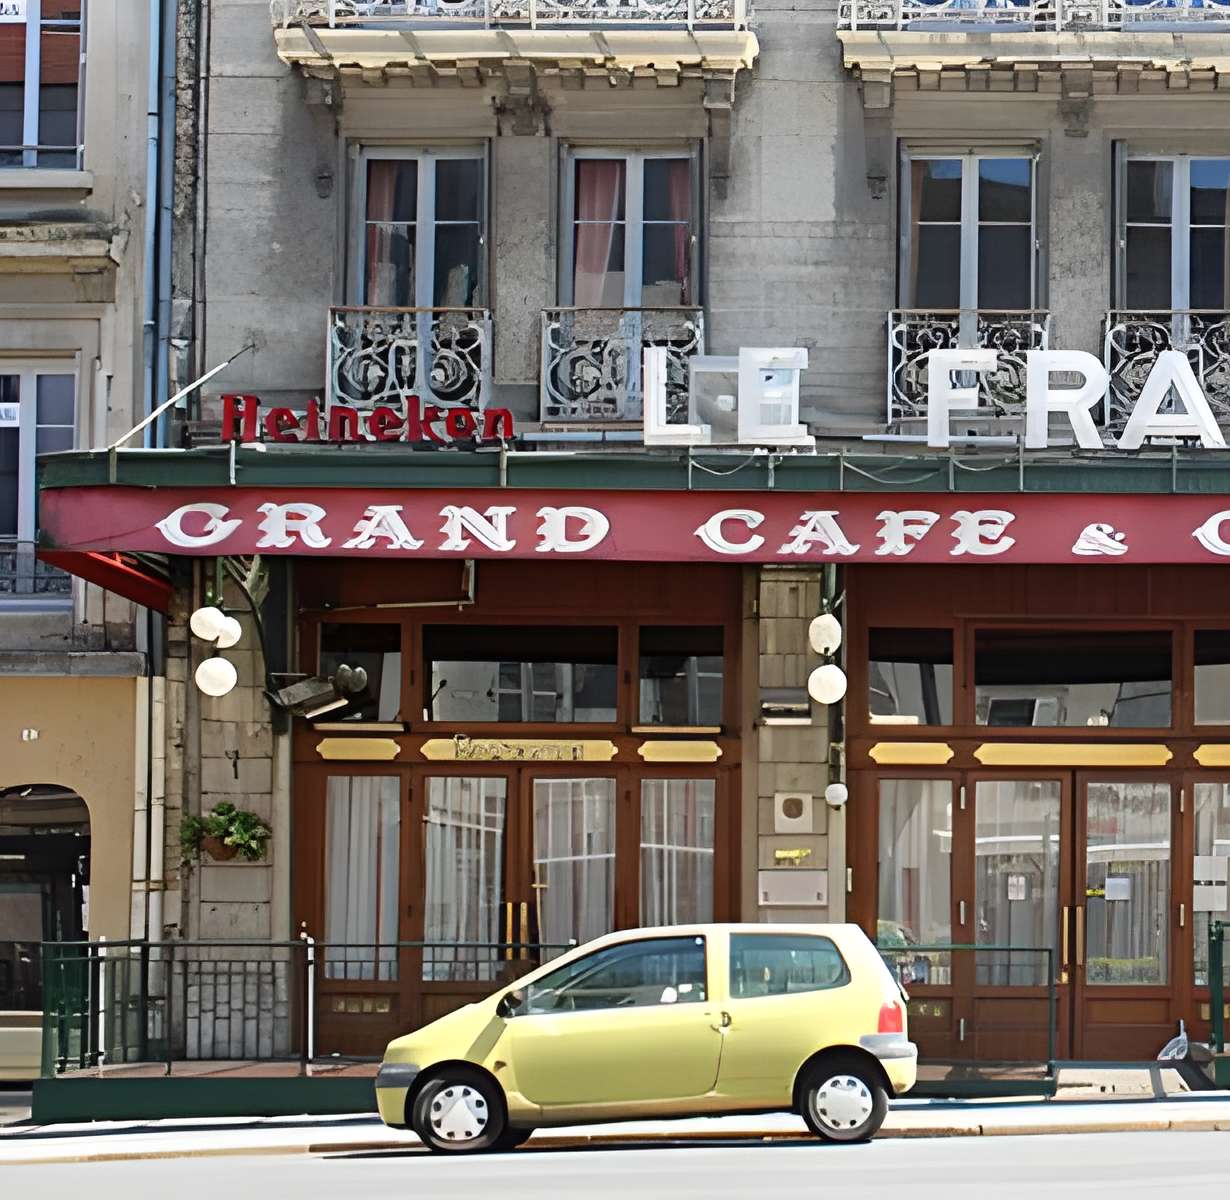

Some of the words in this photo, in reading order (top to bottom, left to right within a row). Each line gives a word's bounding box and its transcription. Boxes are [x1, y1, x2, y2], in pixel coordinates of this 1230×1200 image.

[644, 347, 816, 446] LE
[155, 502, 612, 552] GRAND
[694, 508, 1015, 556] CAFE
[1071, 523, 1129, 556] &
